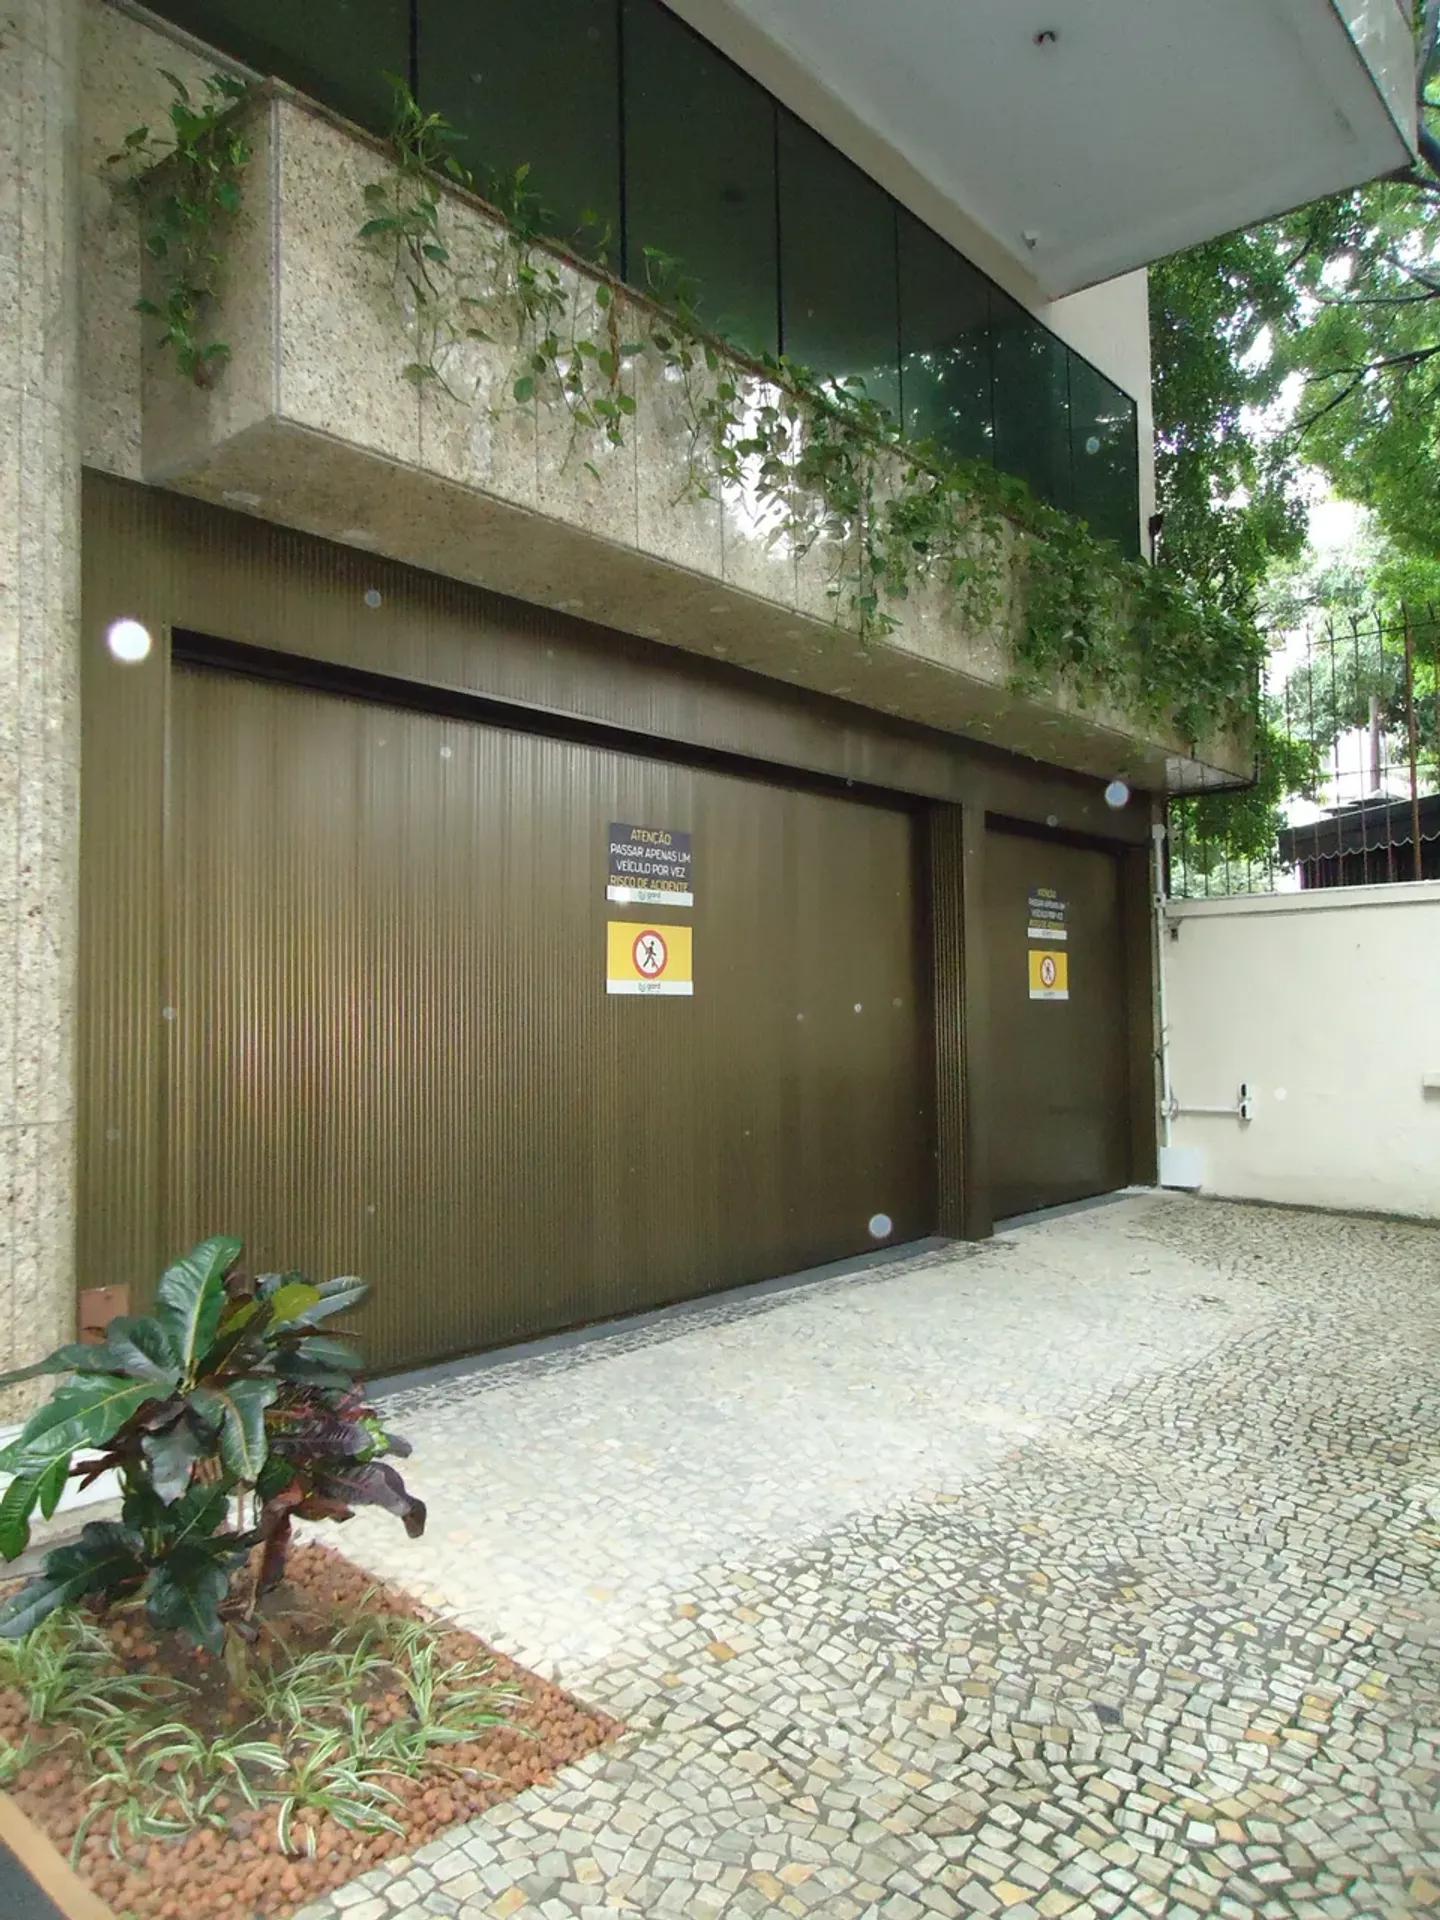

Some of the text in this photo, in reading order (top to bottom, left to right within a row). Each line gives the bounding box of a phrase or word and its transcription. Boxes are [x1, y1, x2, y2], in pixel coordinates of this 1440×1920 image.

[630, 829, 672, 845] ATENÇÃO
[610, 843, 691, 863] PASSAR APENAS UM
[616, 859, 685, 878] VEÍCULO POR VEZ
[610, 875, 689, 893] RISCO DE ACIDENTE
